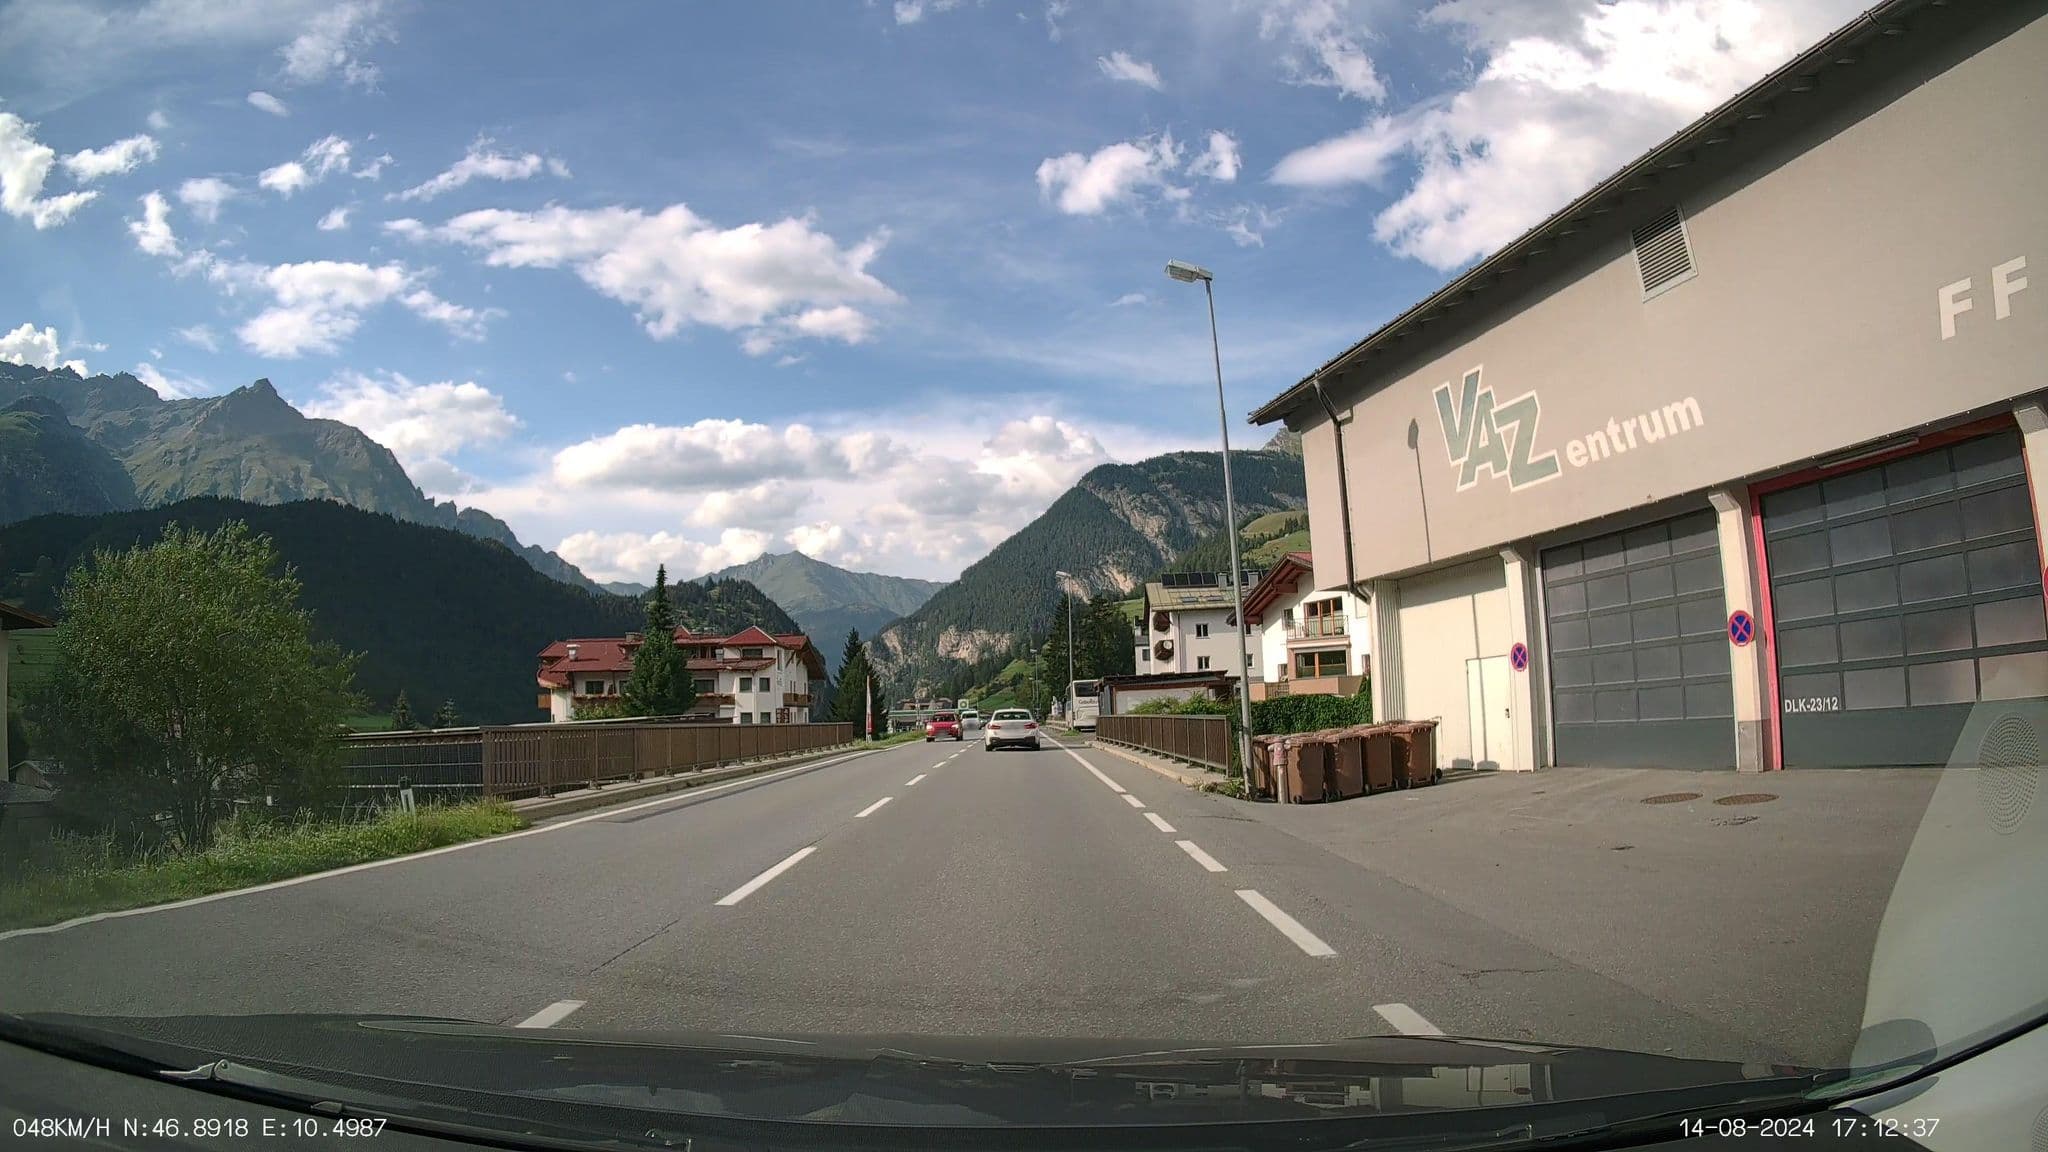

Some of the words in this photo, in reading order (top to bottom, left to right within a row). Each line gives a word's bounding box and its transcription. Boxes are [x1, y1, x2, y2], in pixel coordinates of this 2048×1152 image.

[1432, 364, 1563, 493] VAZ
[1566, 396, 1704, 467] entrum
[1784, 696, 1839, 713] DLK-23/12
